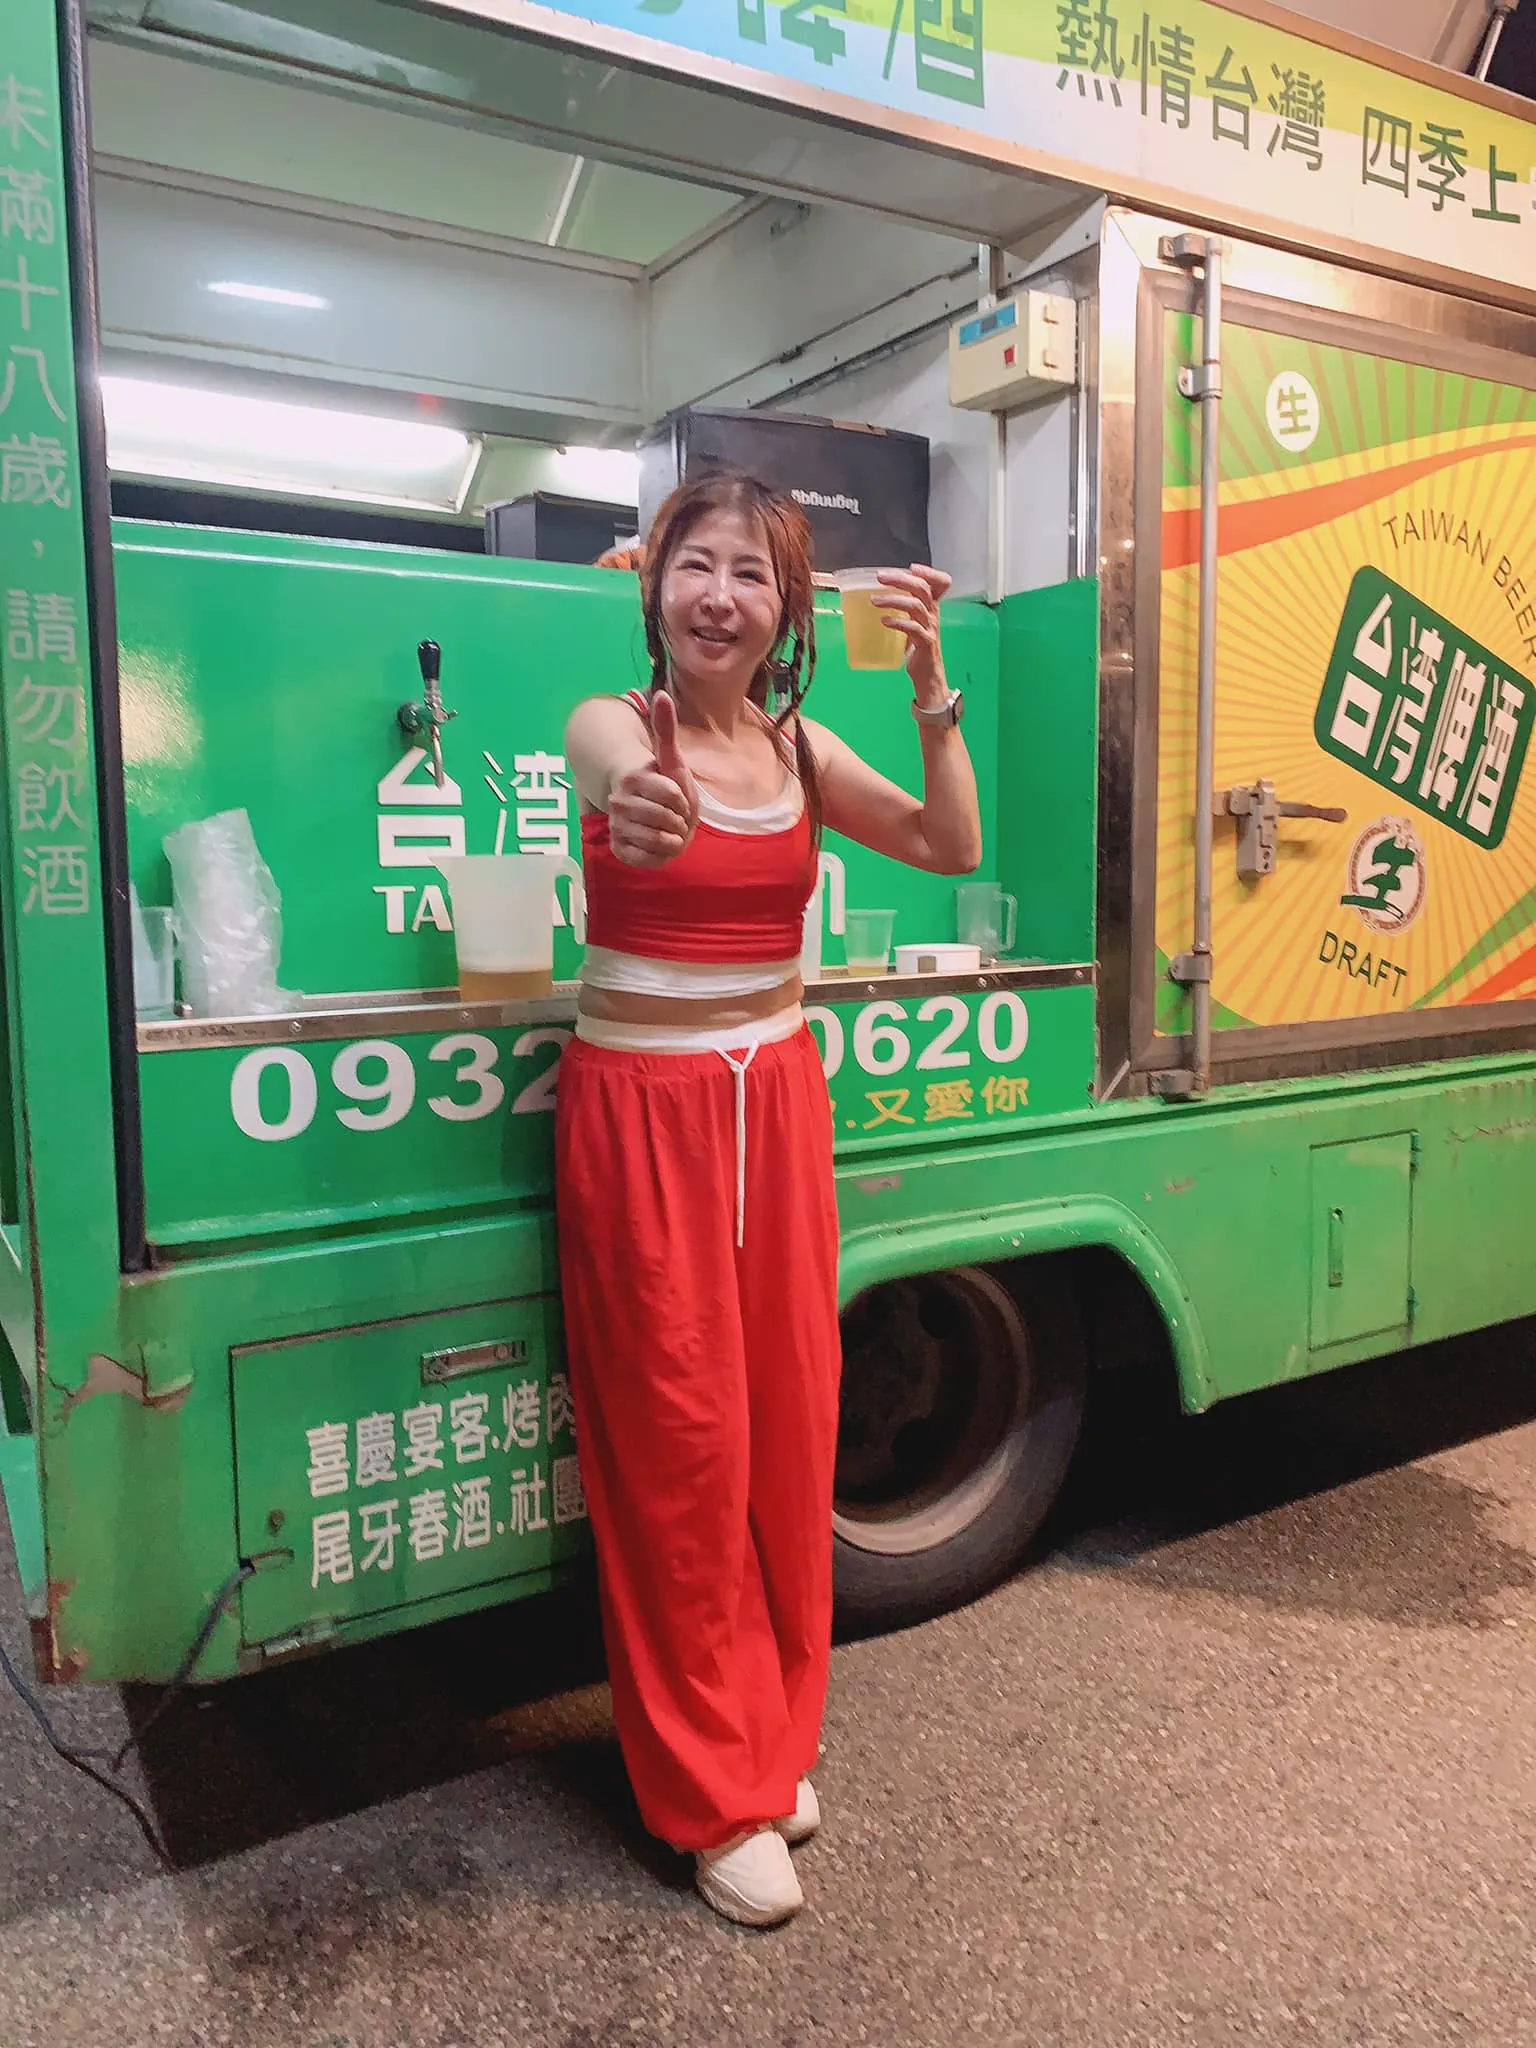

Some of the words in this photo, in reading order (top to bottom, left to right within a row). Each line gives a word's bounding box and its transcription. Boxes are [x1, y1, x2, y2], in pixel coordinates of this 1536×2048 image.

[1055, 0, 1326, 171] 熱情台灣
[1276, 387, 1311, 434] 生
[1382, 508, 1491, 567] TAIWAN
[1319, 930, 1408, 997] DRAFT
[831, 1075, 1029, 1130] .又愛你
